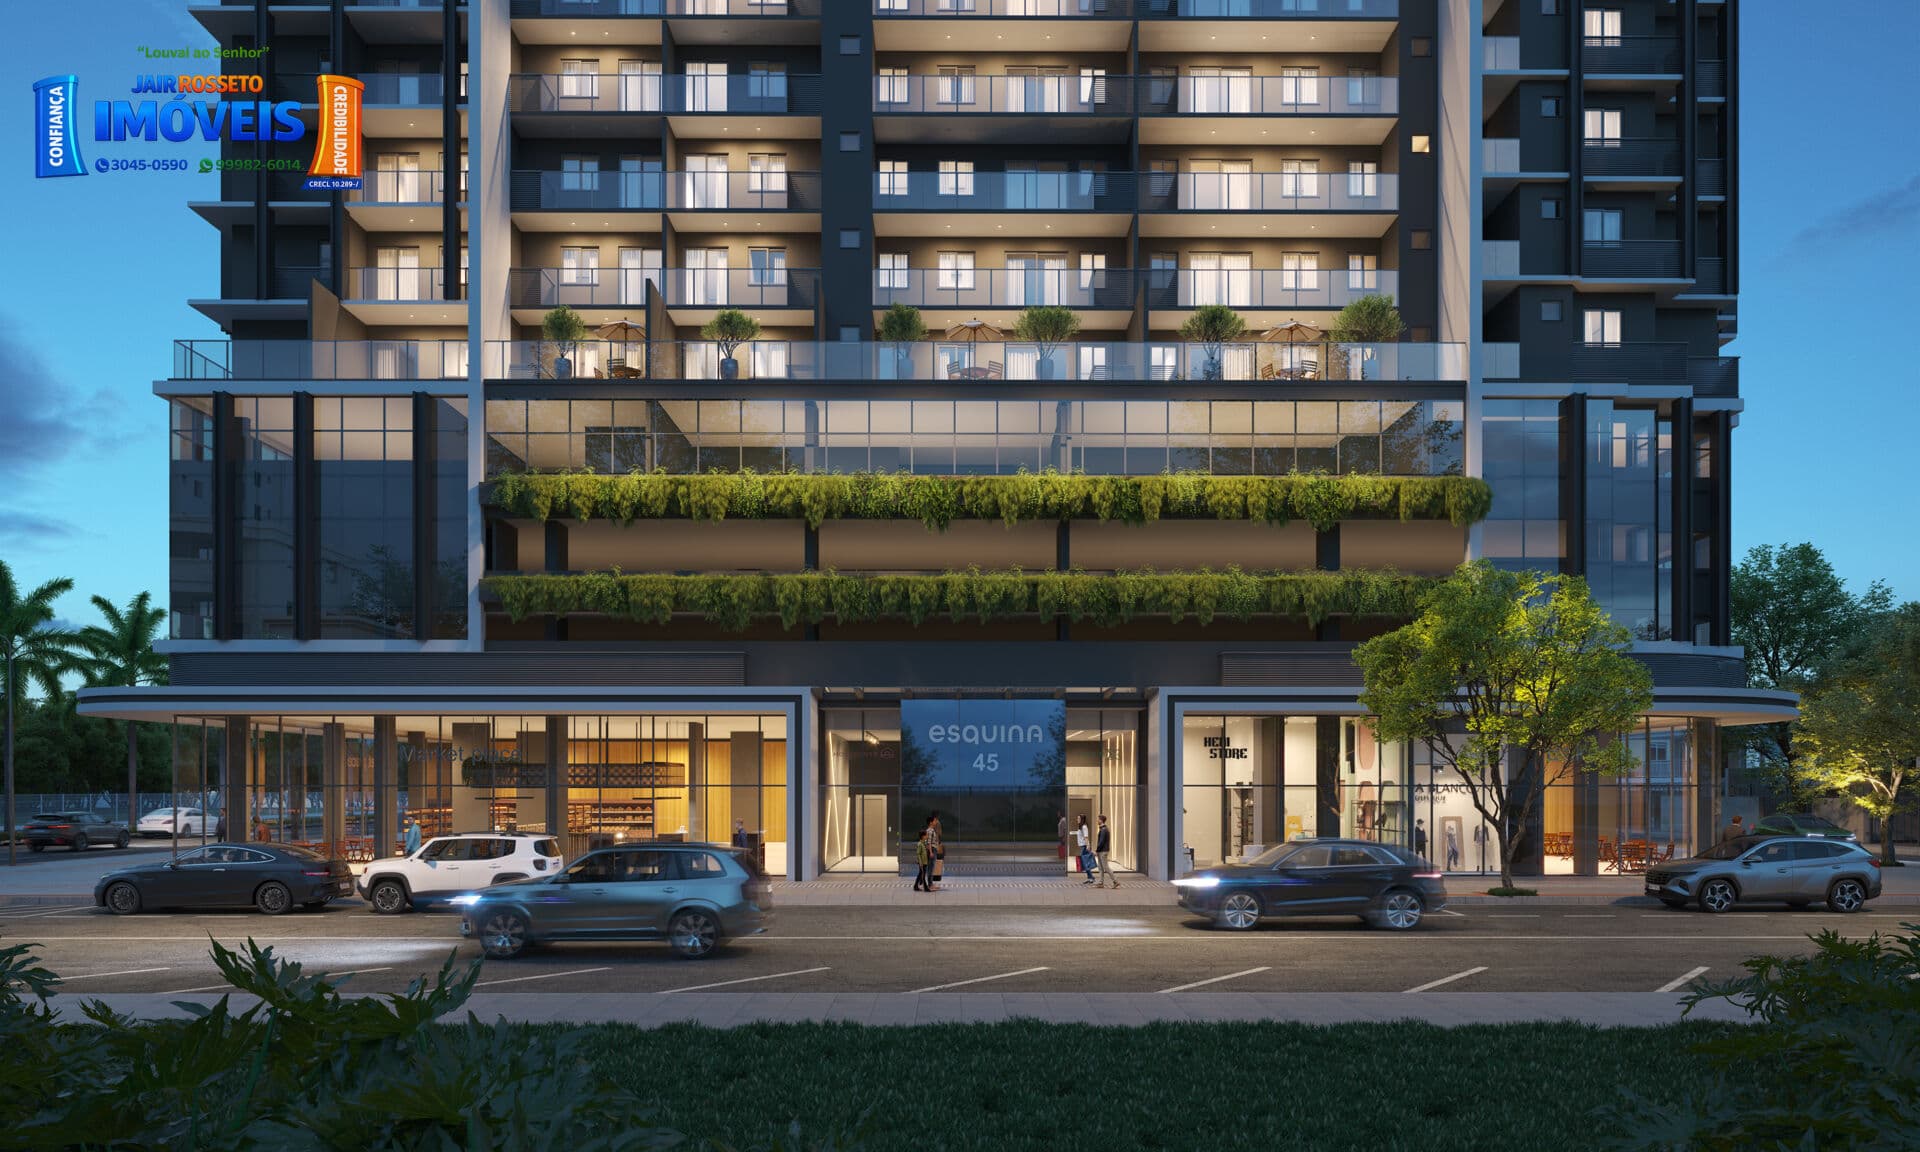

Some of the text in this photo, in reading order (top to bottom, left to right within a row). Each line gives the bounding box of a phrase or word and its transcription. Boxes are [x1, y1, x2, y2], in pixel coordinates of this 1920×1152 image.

[1204, 736, 1230, 747] HEI
[400, 743, 465, 763] Market
[1209, 748, 1248, 759] STORE
[972, 753, 999, 772] 45
